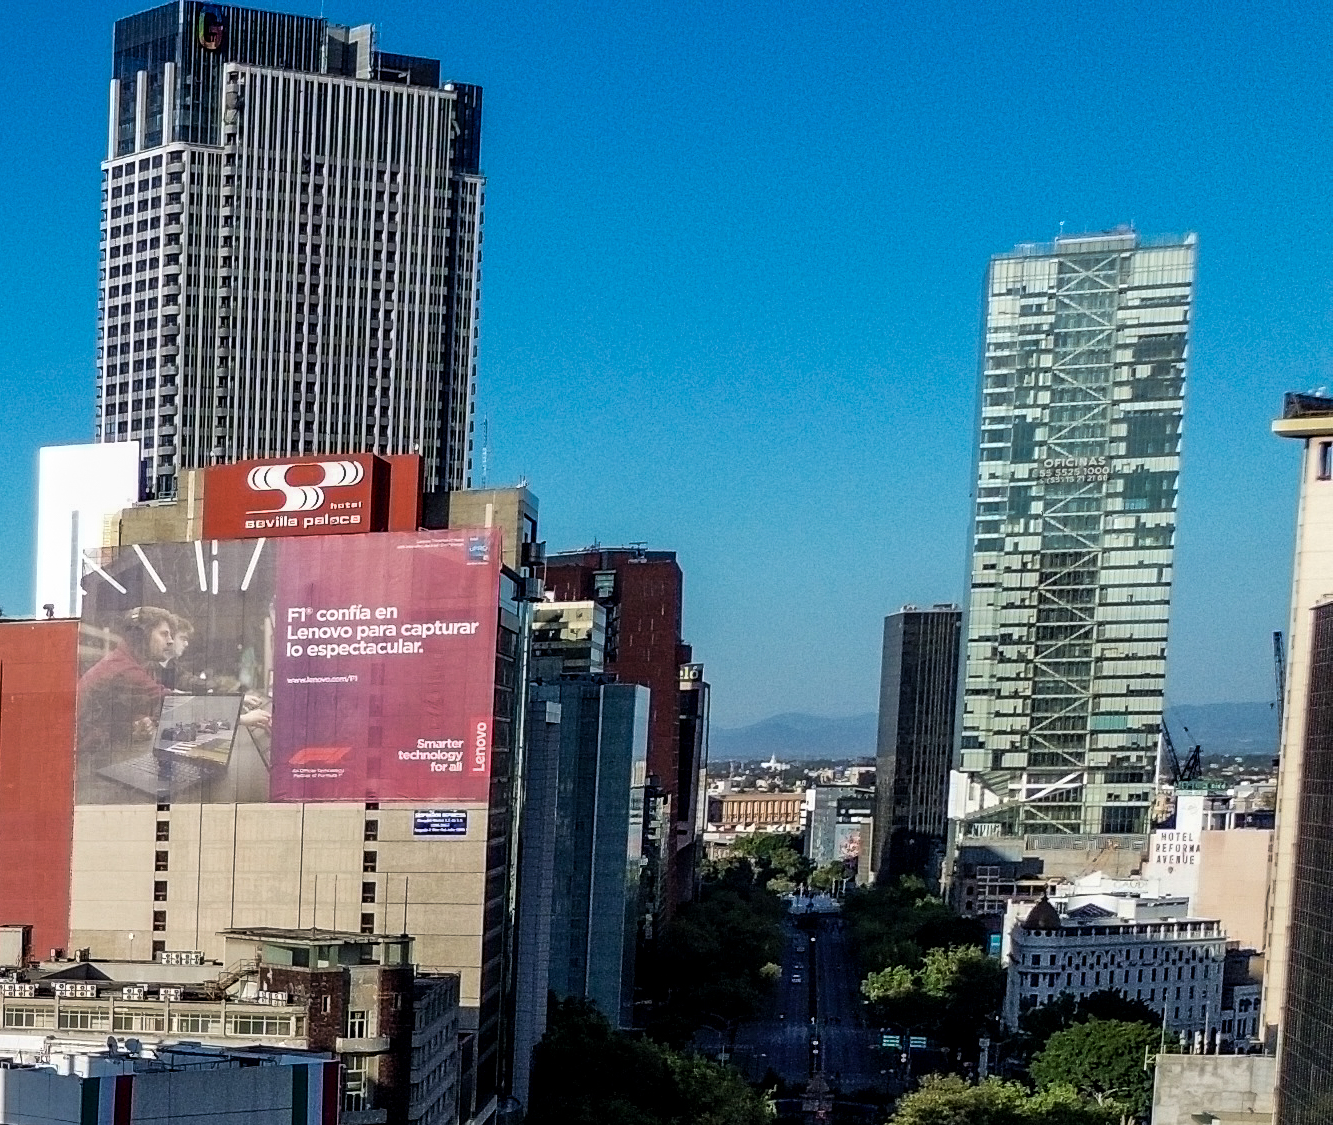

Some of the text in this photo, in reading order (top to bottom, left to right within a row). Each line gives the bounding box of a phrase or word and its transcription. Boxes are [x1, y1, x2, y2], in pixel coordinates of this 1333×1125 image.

[1044, 456, 1105, 467] OFICINAS
[1083, 466, 1109, 475] 1000
[245, 513, 361, 529] sevilla palace
[317, 605, 371, 621] confía
[375, 606, 397, 619] en
[287, 621, 479, 640] Lenovo para capturar
[287, 639, 424, 658] lo espectacular.
[417, 739, 464, 748] Smarter
[473, 722, 487, 772] Lenovo
[398, 750, 463, 761] technology
[431, 762, 463, 772] for all
[1161, 833, 1193, 841] HOTEL
[1156, 844, 1200, 852] REFORMA
[1156, 855, 1195, 865] AVENUE
